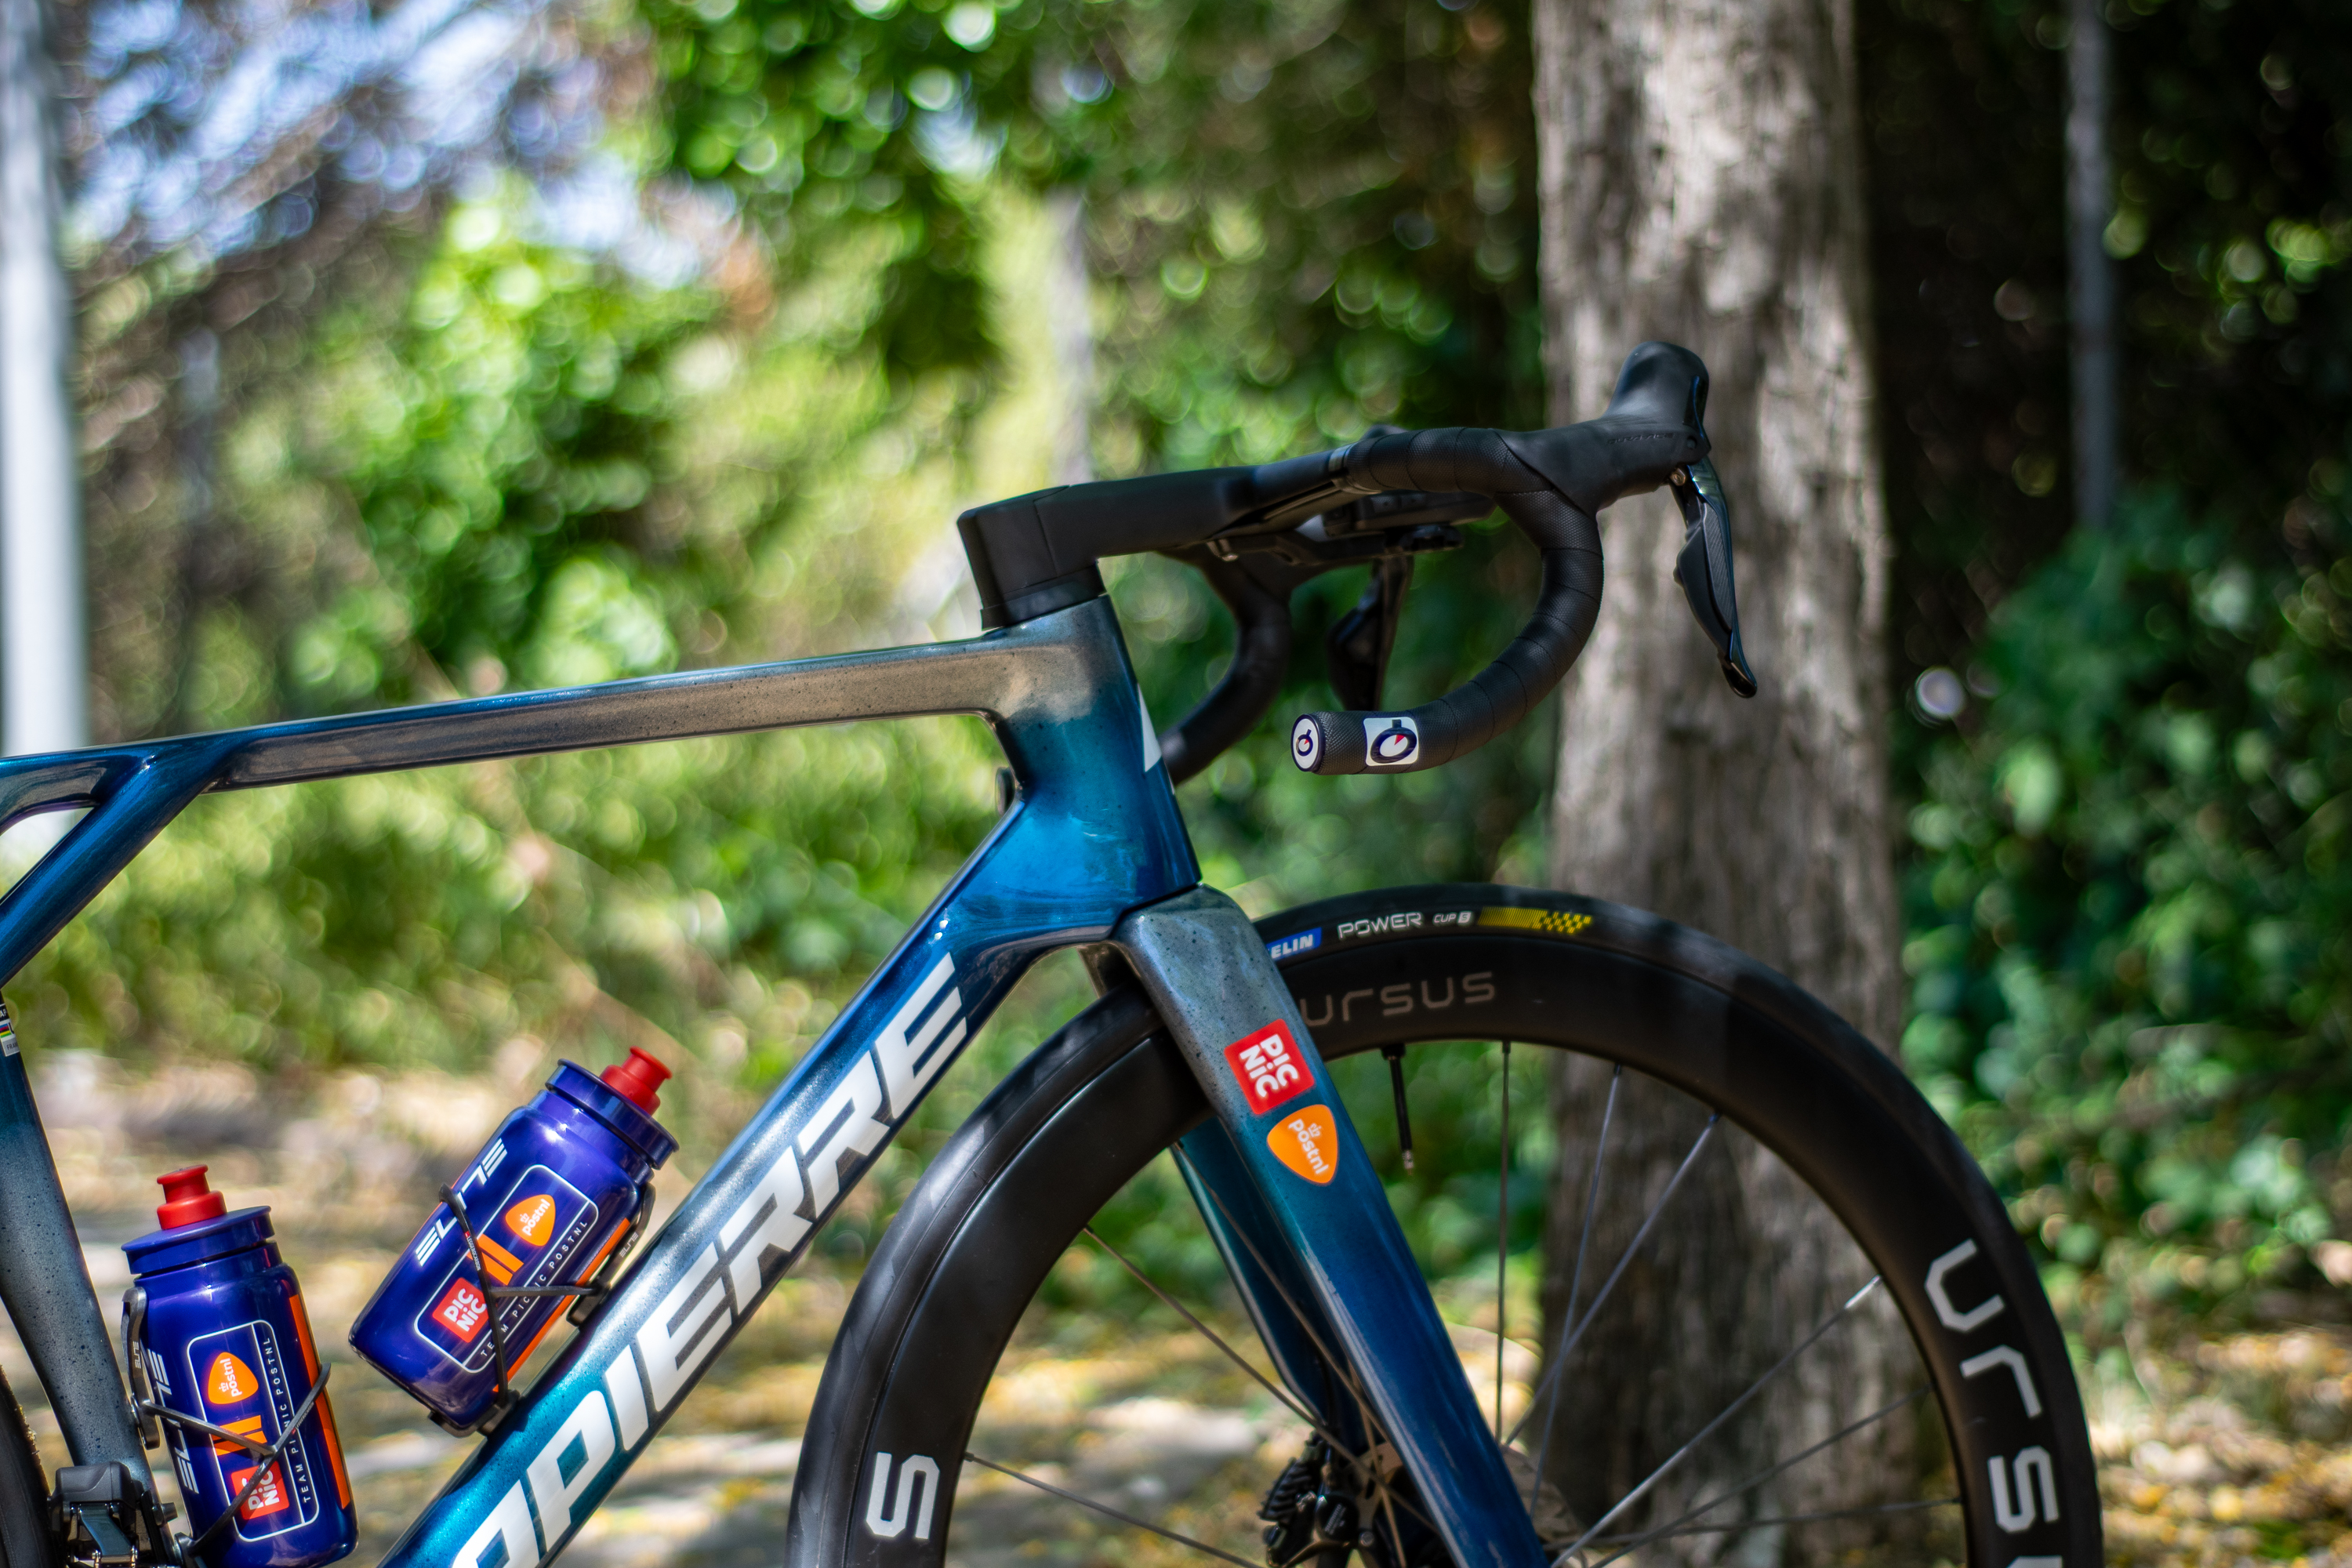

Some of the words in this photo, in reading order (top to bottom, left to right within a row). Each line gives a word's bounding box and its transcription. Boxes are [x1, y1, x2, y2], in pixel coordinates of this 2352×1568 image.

[1269, 934, 1314, 959] ELIN
[1338, 912, 1422, 939] POWER
[1433, 913, 1457, 924] CUP
[1260, 1033, 1299, 1087] PIC
[1288, 1118, 1330, 1175] postnl
[521, 1198, 551, 1237] postnl
[443, 1287, 474, 1323] PIC
[480, 1324, 509, 1357] TEM
[512, 1273, 547, 1318] PICIC
[549, 1220, 588, 1269] POSTNL
[220, 1357, 243, 1398] postnl
[263, 1337, 285, 1396] POSTNL
[280, 1403, 299, 1454] PINIC
[296, 1464, 312, 1504] TEAM
